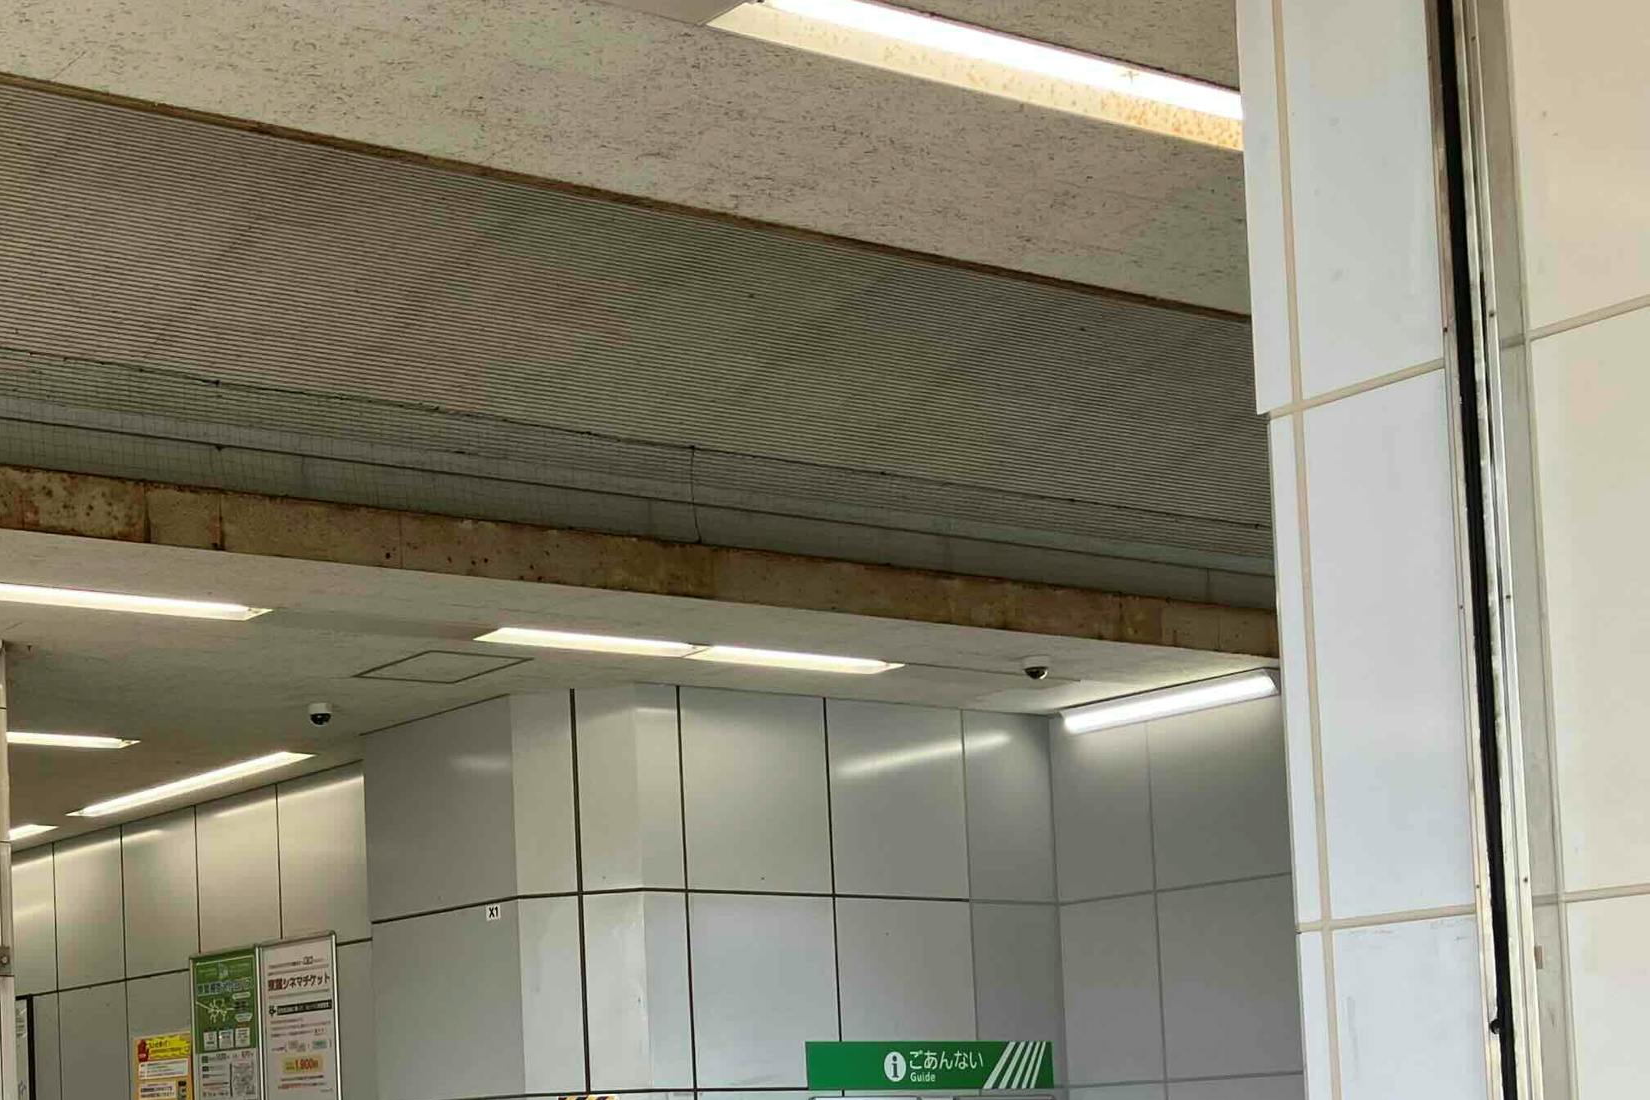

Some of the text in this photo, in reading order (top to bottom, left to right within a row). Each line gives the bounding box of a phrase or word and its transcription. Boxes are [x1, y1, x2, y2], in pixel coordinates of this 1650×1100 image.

[488, 906, 499, 918] X1
[910, 1050, 983, 1070] ごあんない
[910, 1072, 936, 1082] Guide
